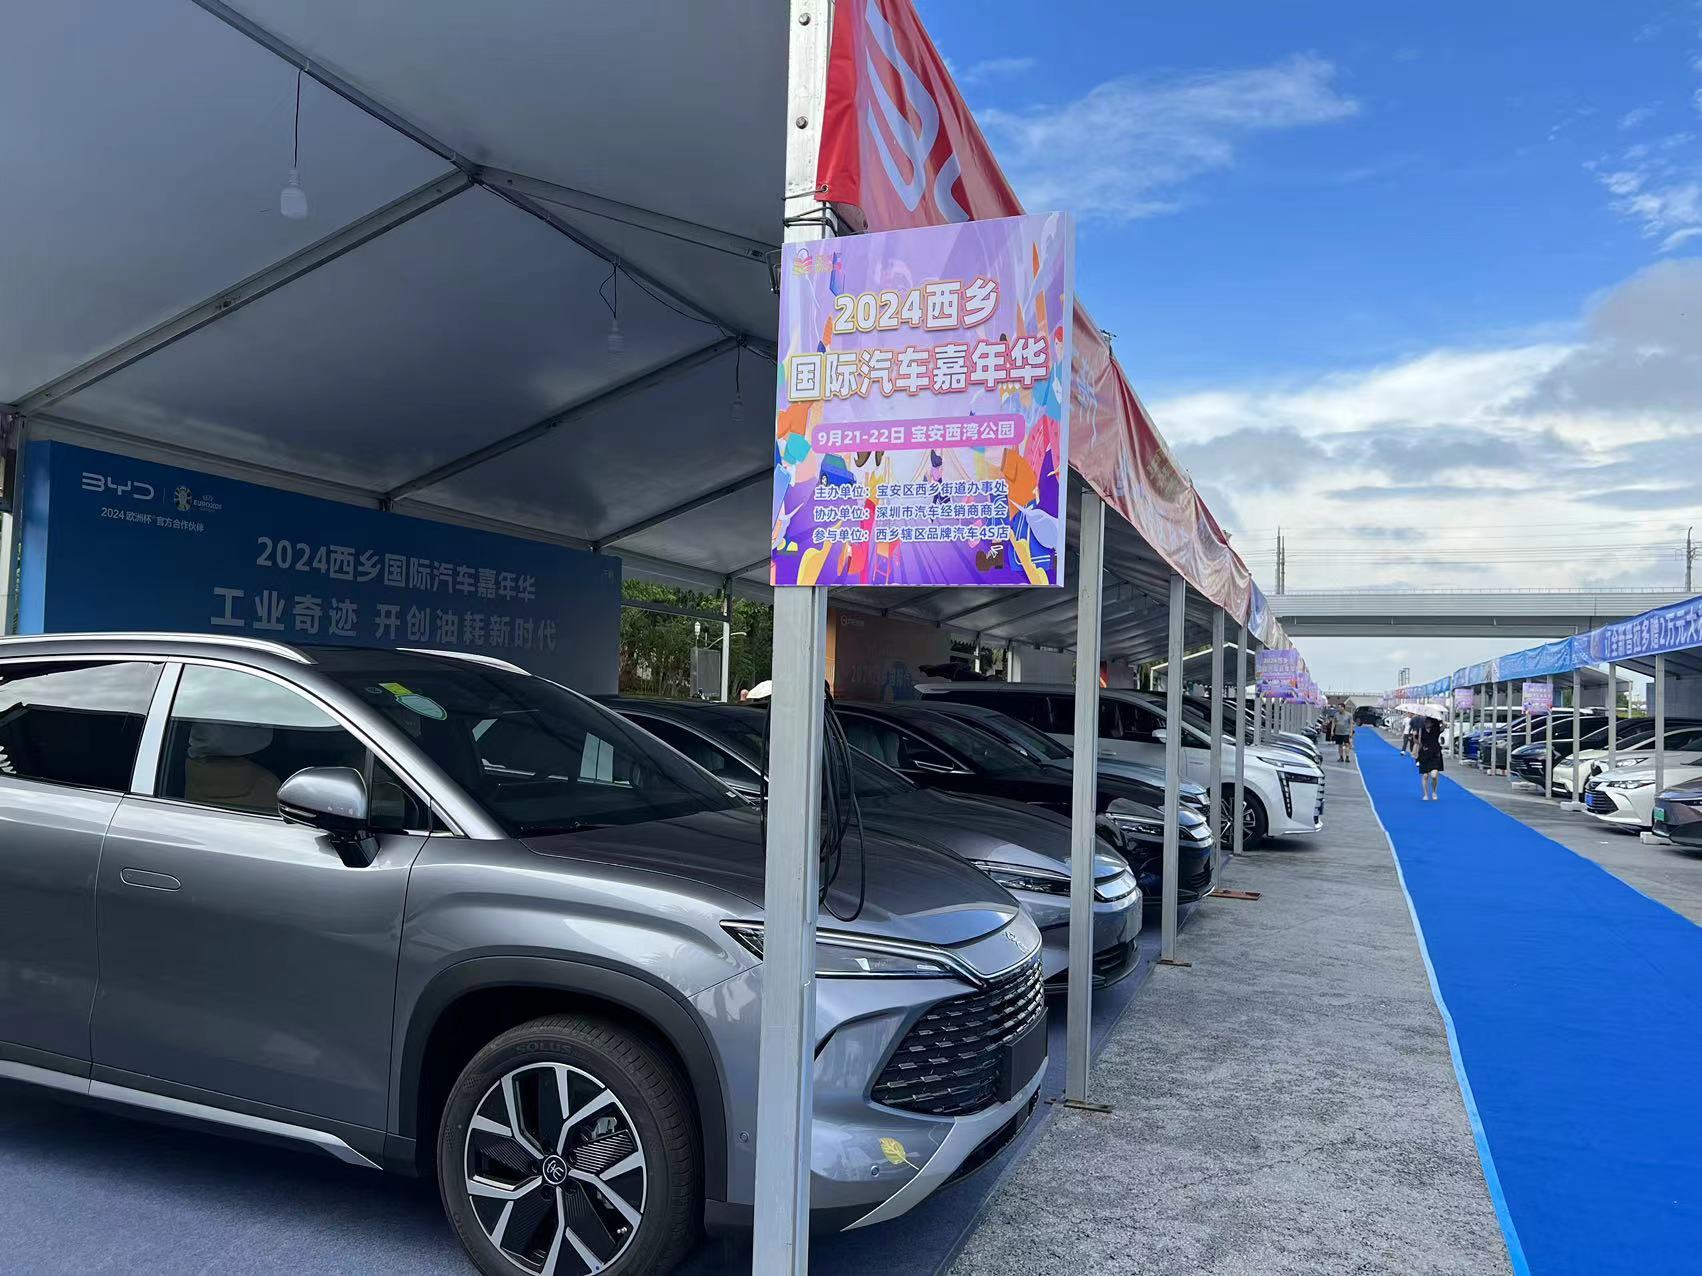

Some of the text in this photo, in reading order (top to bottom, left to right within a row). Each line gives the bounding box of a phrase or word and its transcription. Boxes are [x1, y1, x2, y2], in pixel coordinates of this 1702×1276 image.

[834, 277, 999, 334] 2024西乡
[788, 337, 1048, 401] 国际汽车嘉年华
[817, 421, 1015, 446] 9月21-22日 宝安西湾公园
[82, 472, 154, 500] BYD
[256, 536, 537, 603] 2024西乡国际汽车嘉年华
[210, 587, 560, 651] 工业奇迹 开创油耗新时代
